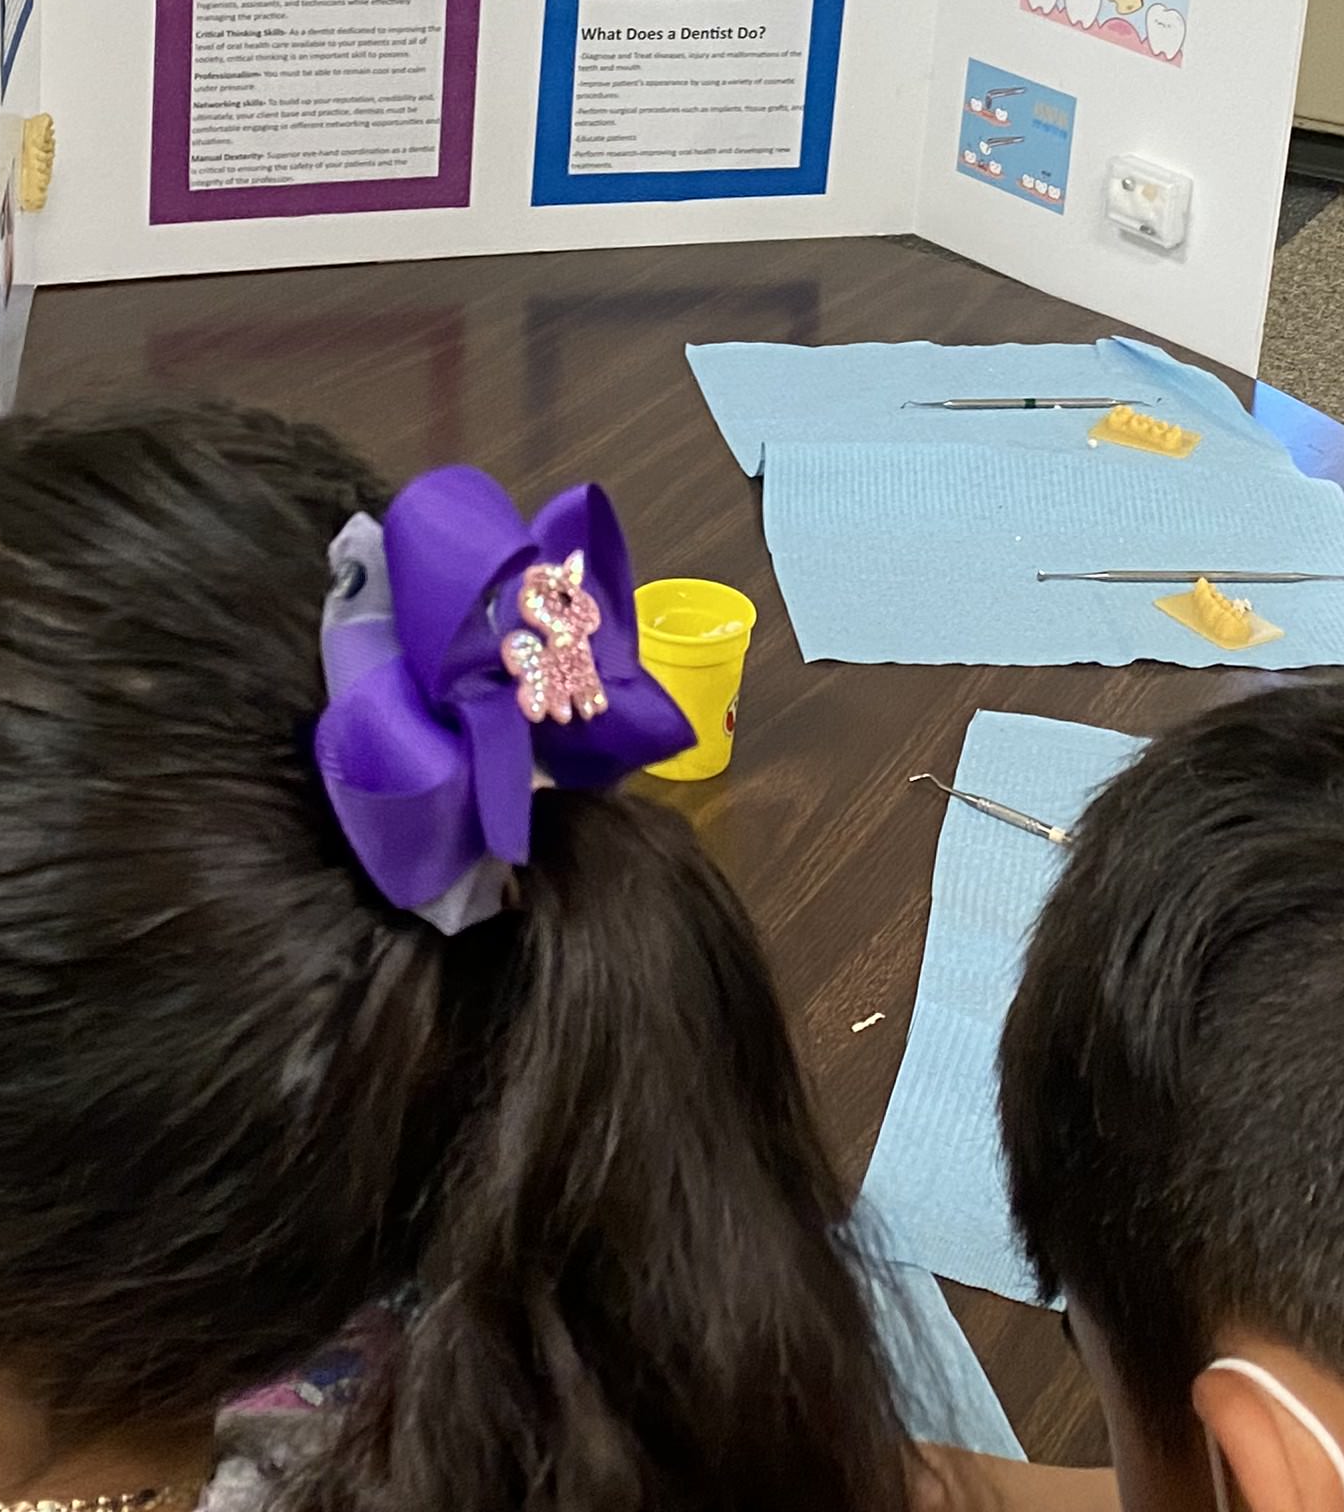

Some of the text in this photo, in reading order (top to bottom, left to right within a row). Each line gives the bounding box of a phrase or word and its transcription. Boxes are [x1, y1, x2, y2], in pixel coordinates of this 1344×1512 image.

[581, 26, 766, 40] What Does a Dentist Do?
